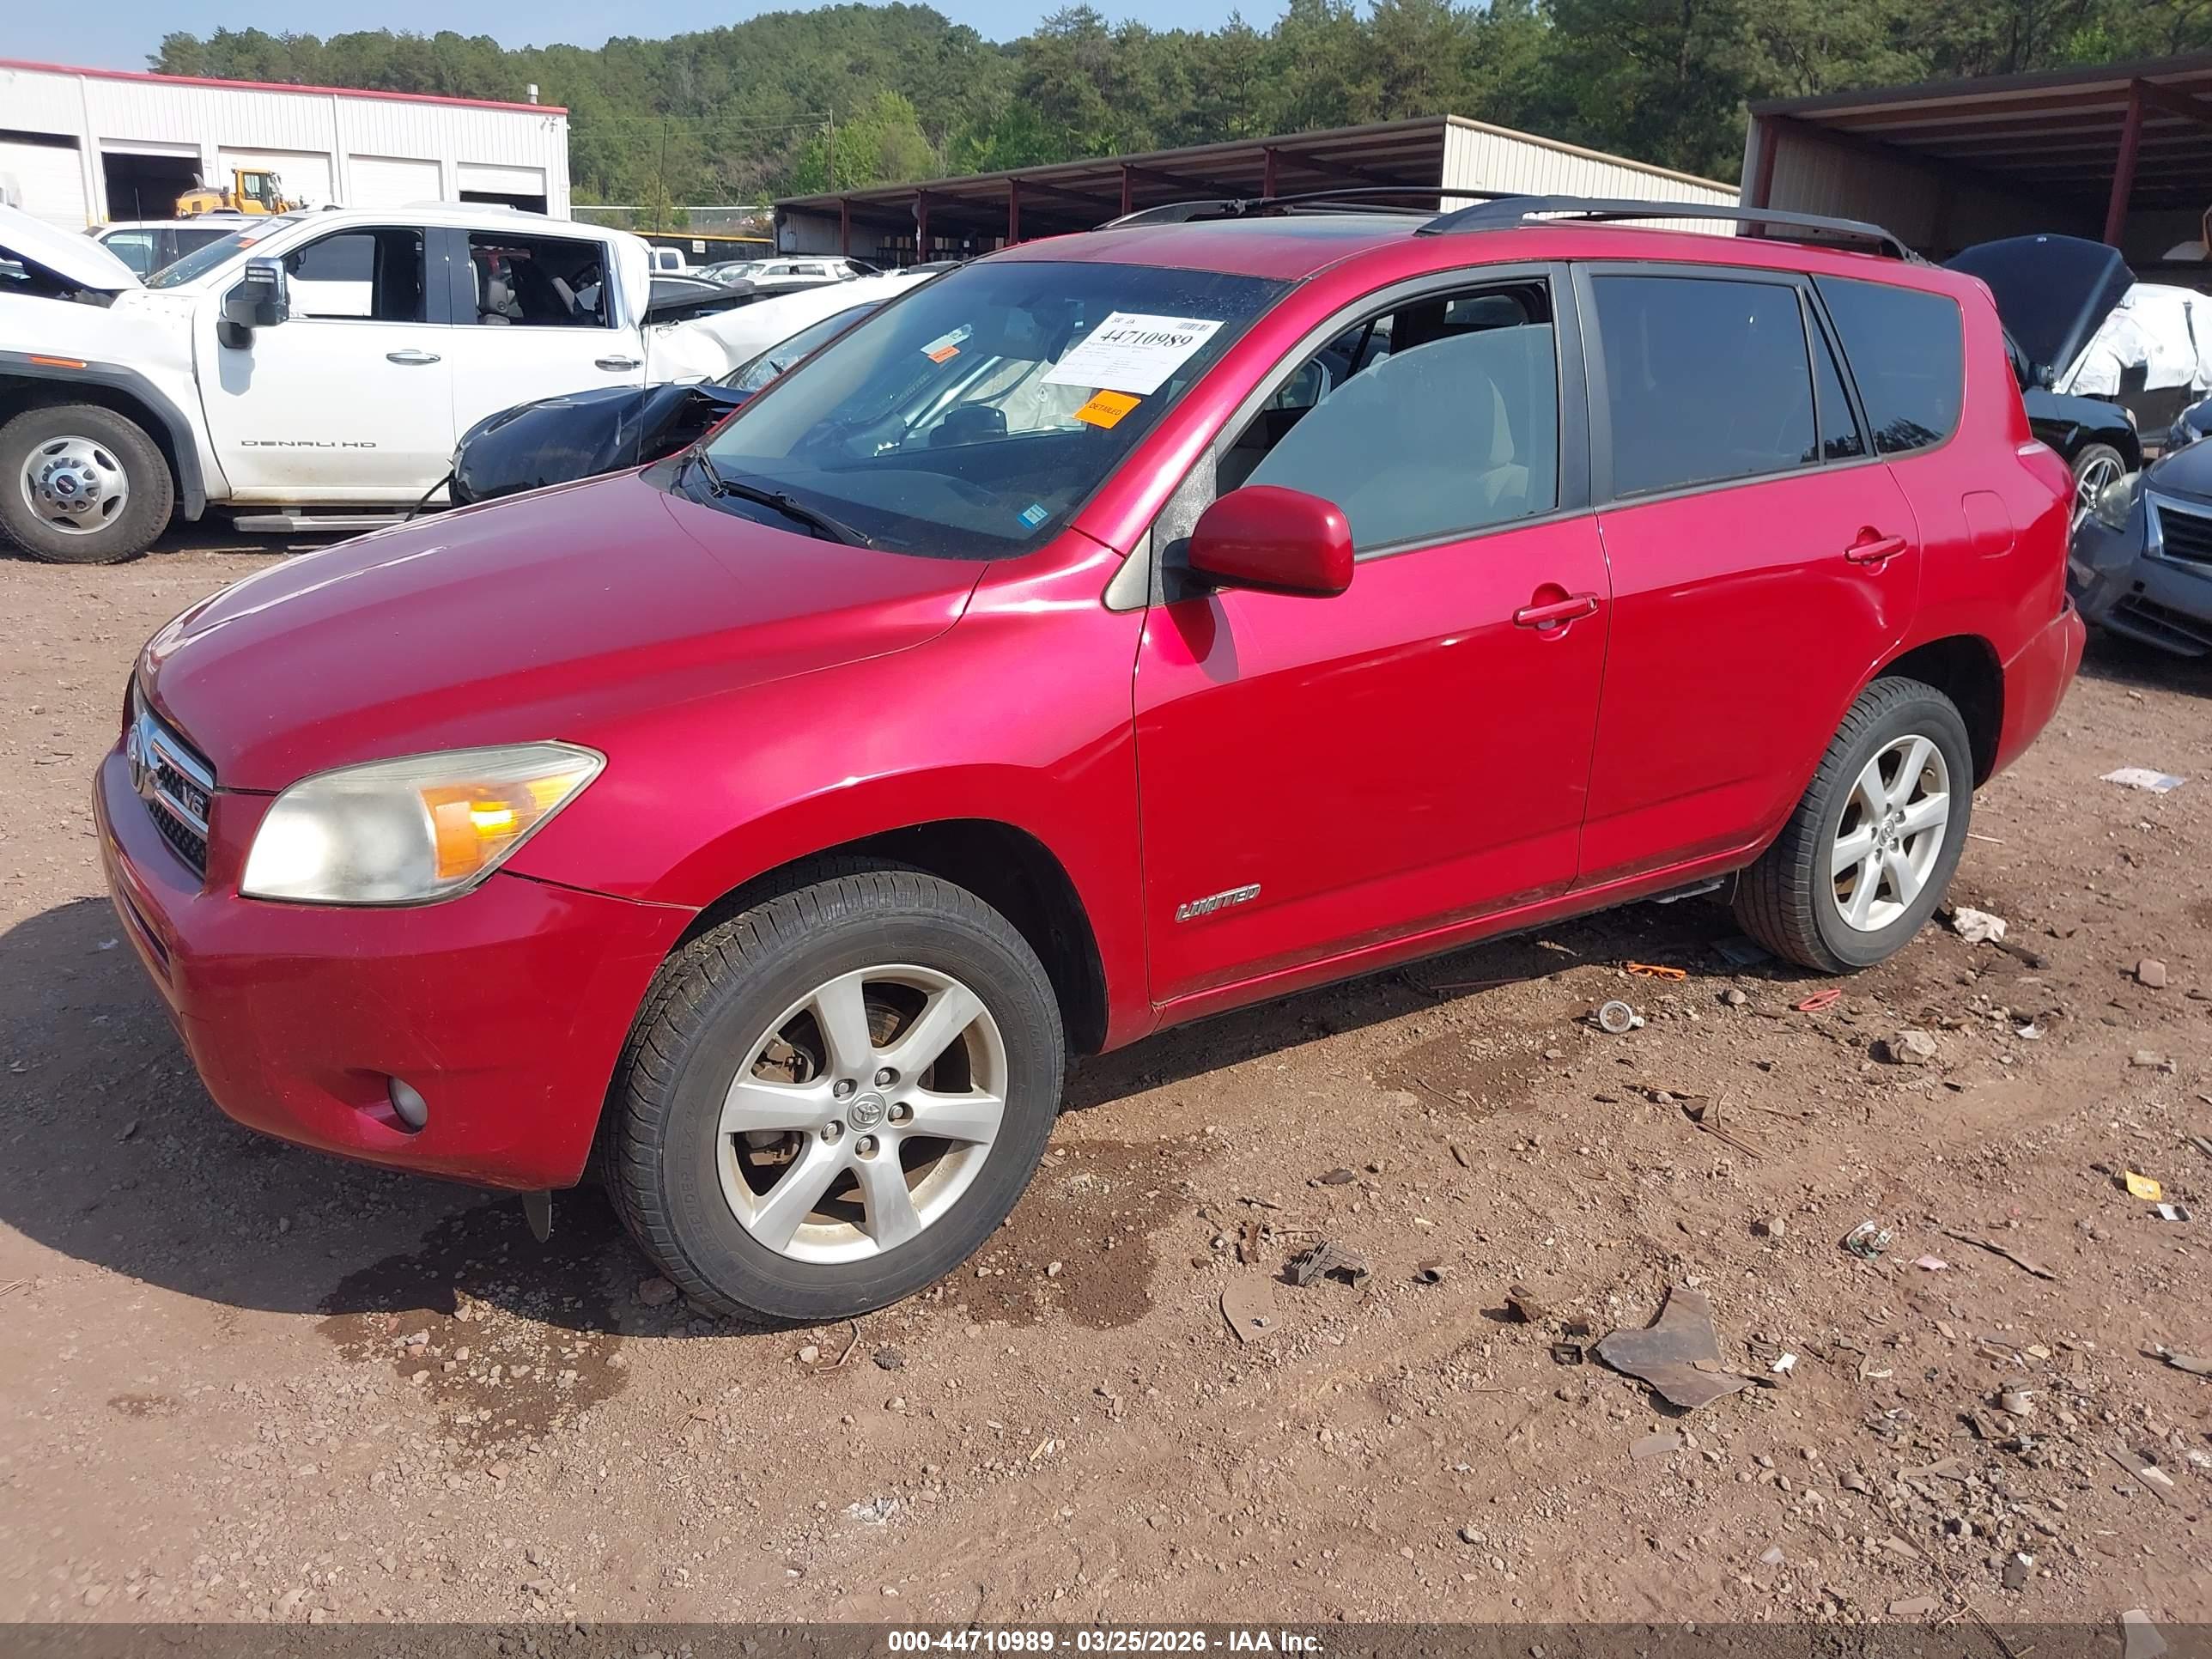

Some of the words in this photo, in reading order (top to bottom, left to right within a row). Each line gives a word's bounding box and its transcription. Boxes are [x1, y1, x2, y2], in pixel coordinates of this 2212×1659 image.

[1100, 329, 1194, 349] 44710989
[1089, 403, 1122, 416] DETAILED
[182, 786, 204, 818] V6
[1176, 884, 1261, 921] LIMITED
